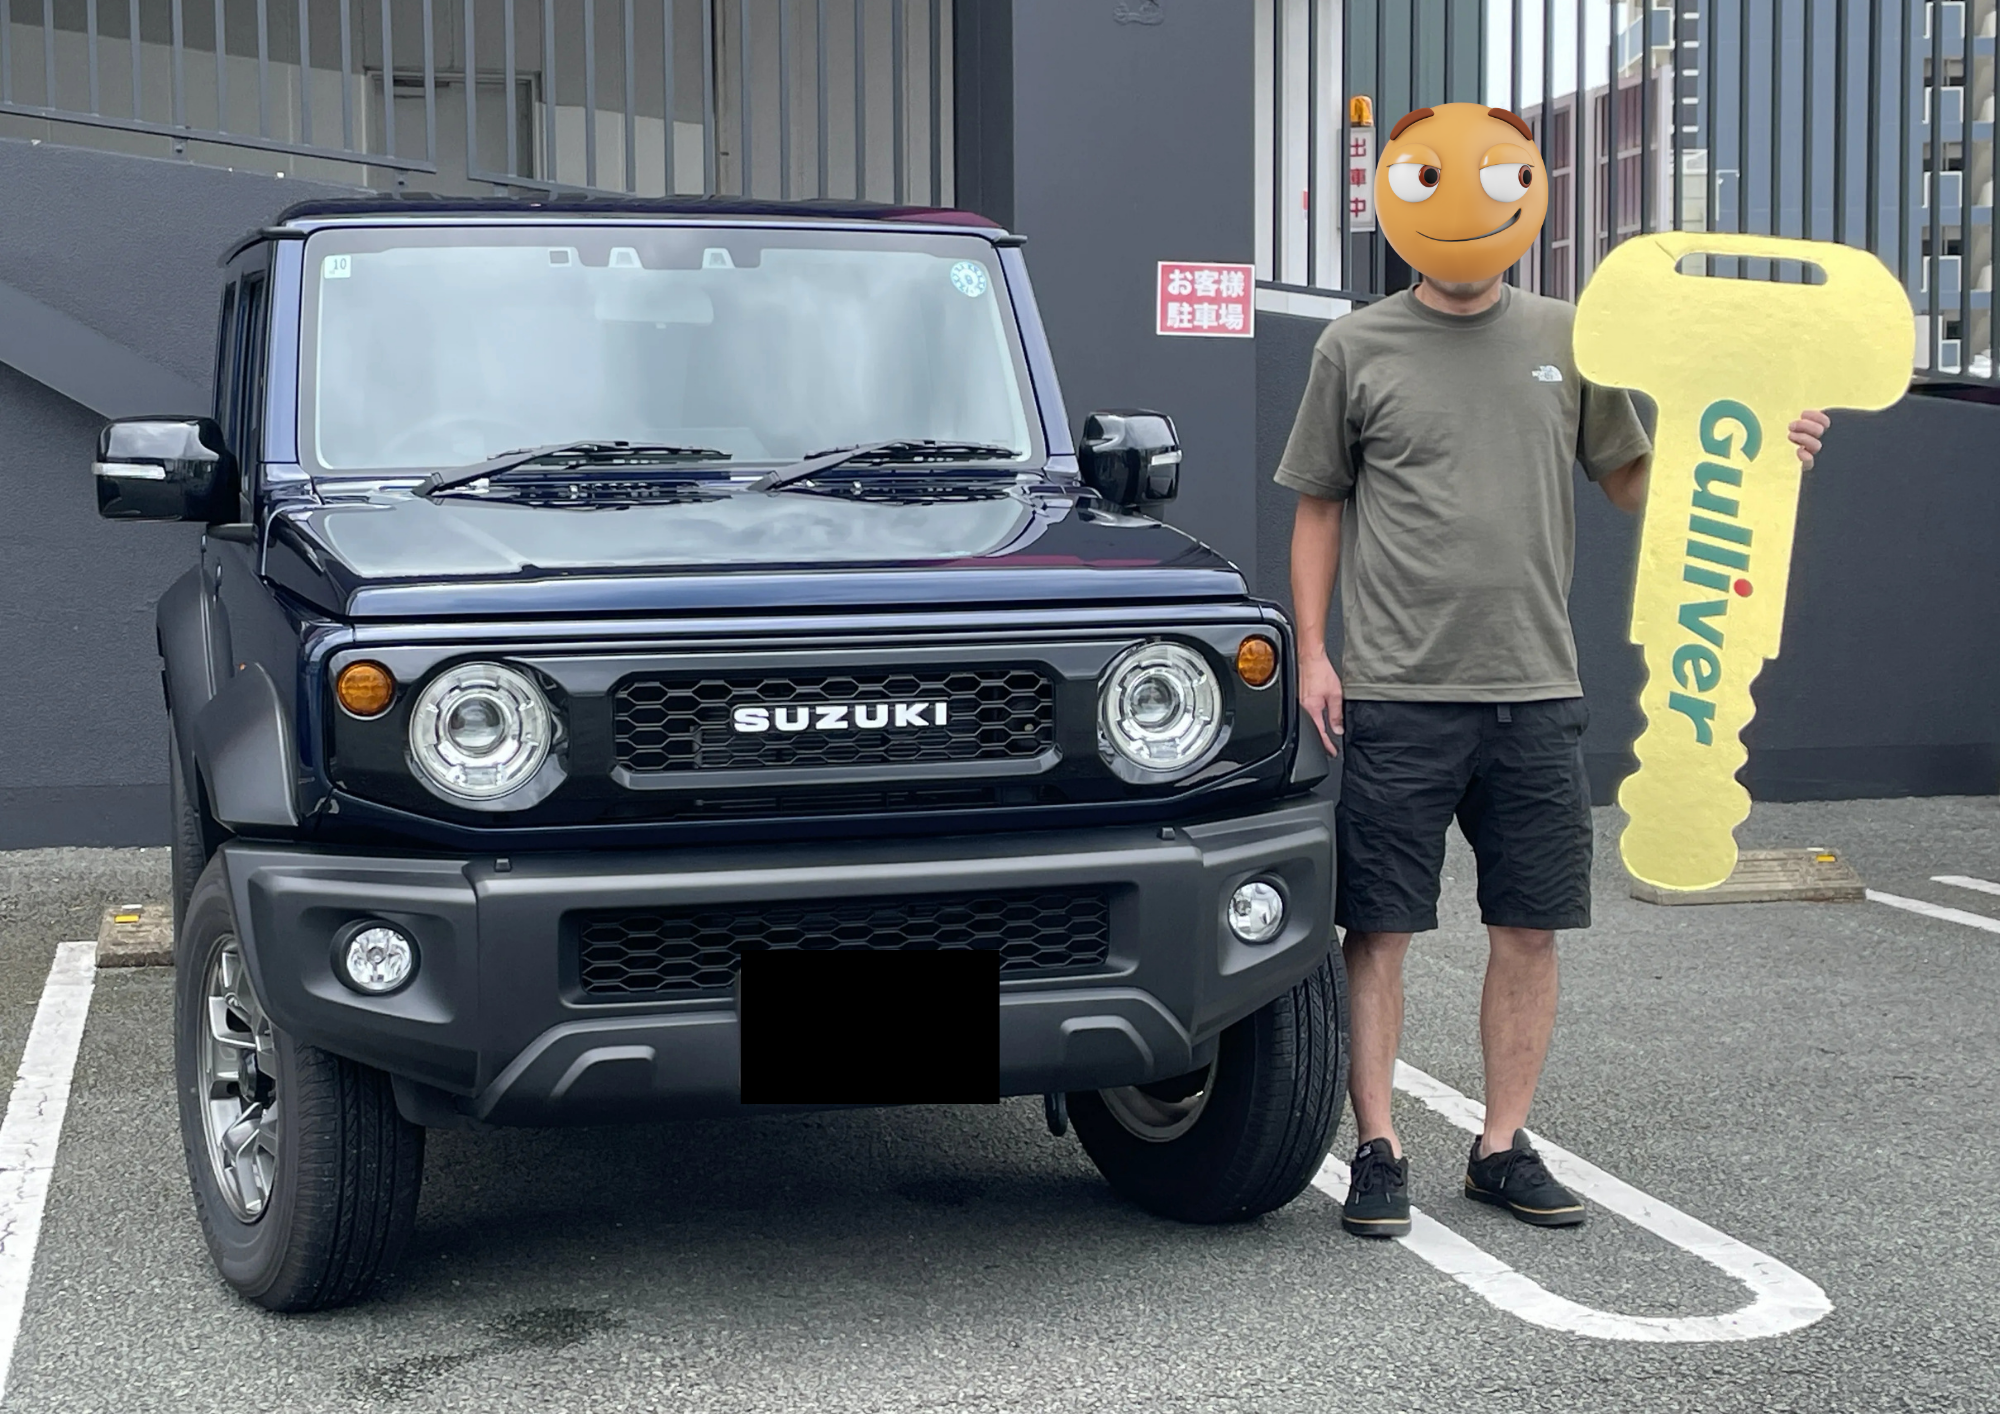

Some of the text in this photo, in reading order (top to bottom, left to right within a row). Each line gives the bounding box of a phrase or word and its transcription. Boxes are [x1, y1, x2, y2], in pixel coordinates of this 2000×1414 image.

[333, 258, 347, 270] 10
[1167, 269, 1245, 297] お客様
[1166, 302, 1245, 330] 駐車場
[1669, 400, 1763, 746] Gulliver
[733, 702, 948, 732] SUZUKI
